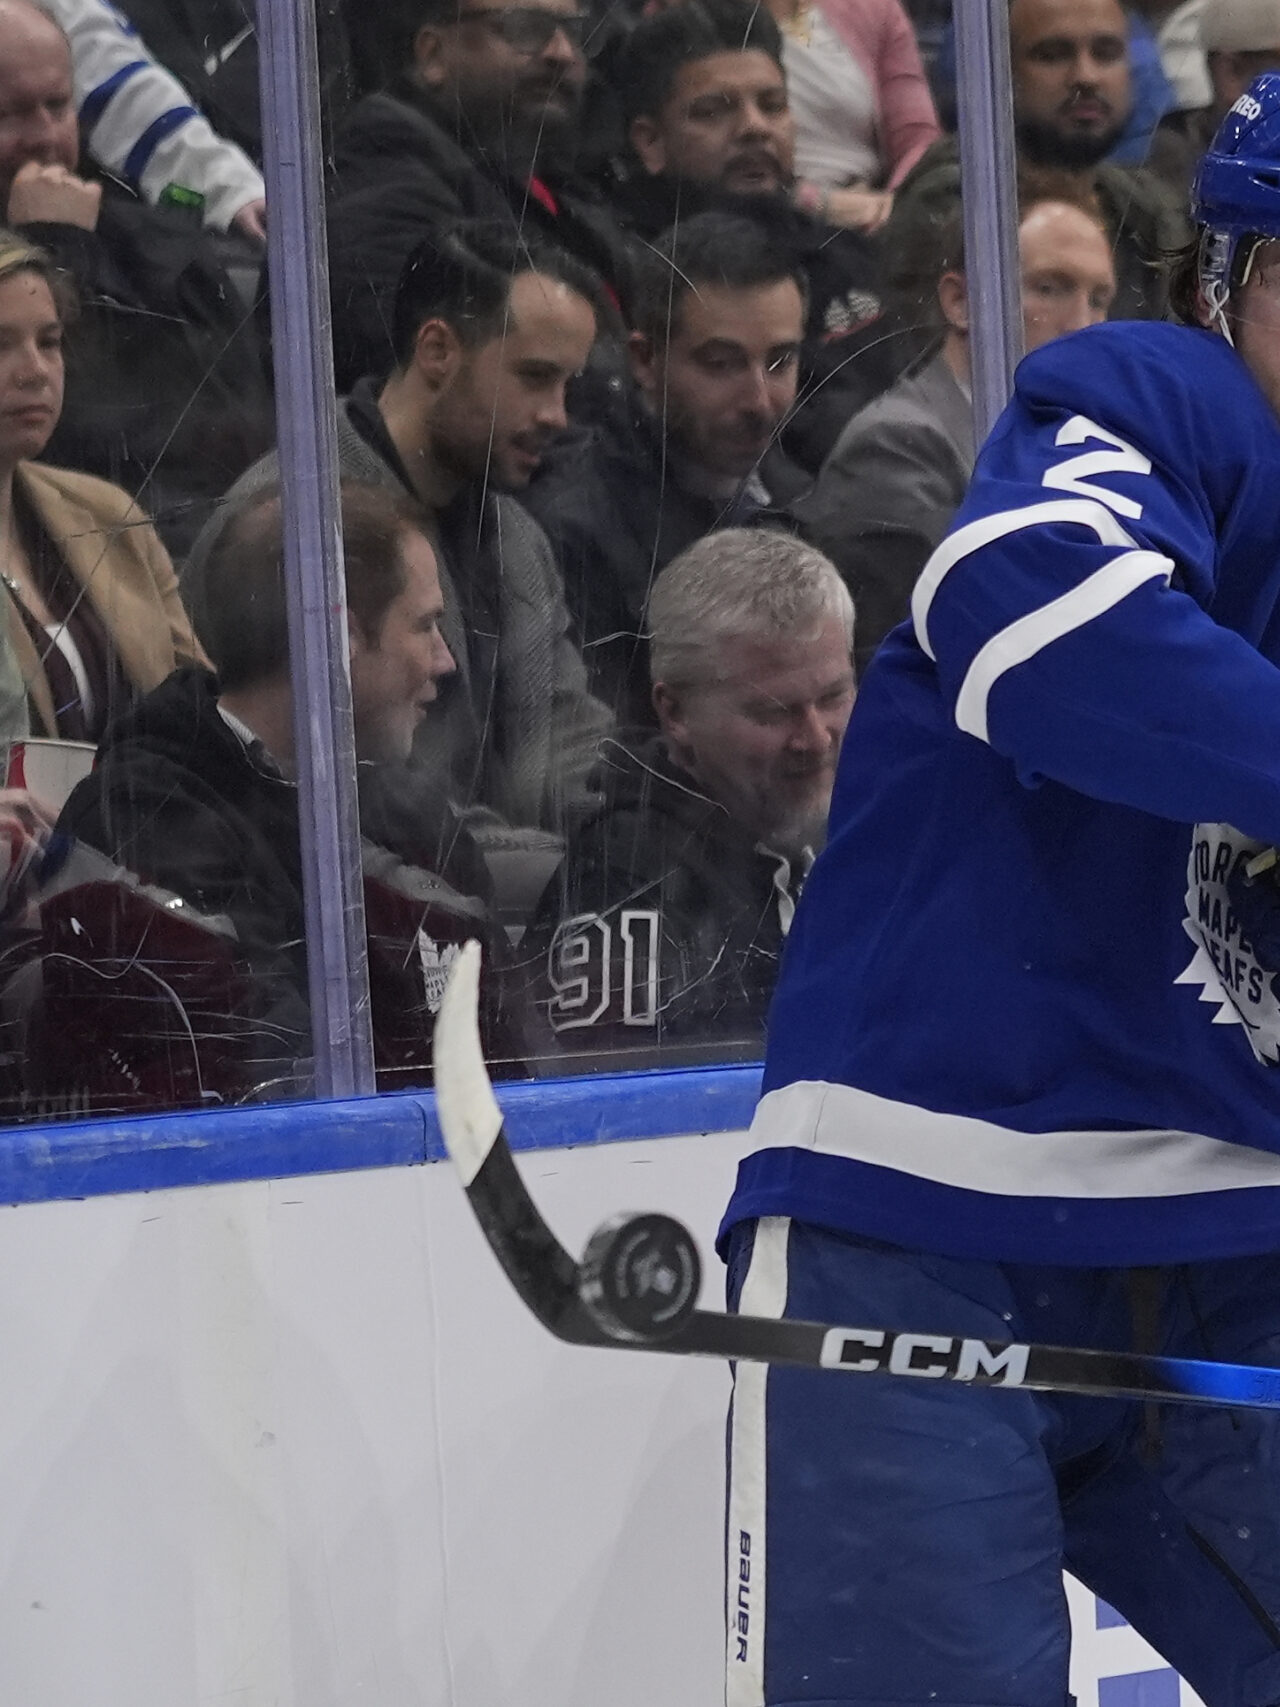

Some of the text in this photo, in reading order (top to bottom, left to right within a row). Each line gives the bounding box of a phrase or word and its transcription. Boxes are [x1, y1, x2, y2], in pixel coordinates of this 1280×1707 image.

[1230, 94, 1261, 121] REO
[1041, 414, 1152, 520] 2
[1199, 886, 1252, 954] MAPL
[549, 910, 659, 1031] 91
[1210, 938, 1264, 1005] EAFS
[819, 1327, 1031, 1387] CCM
[735, 1529, 752, 1663] BAUER
